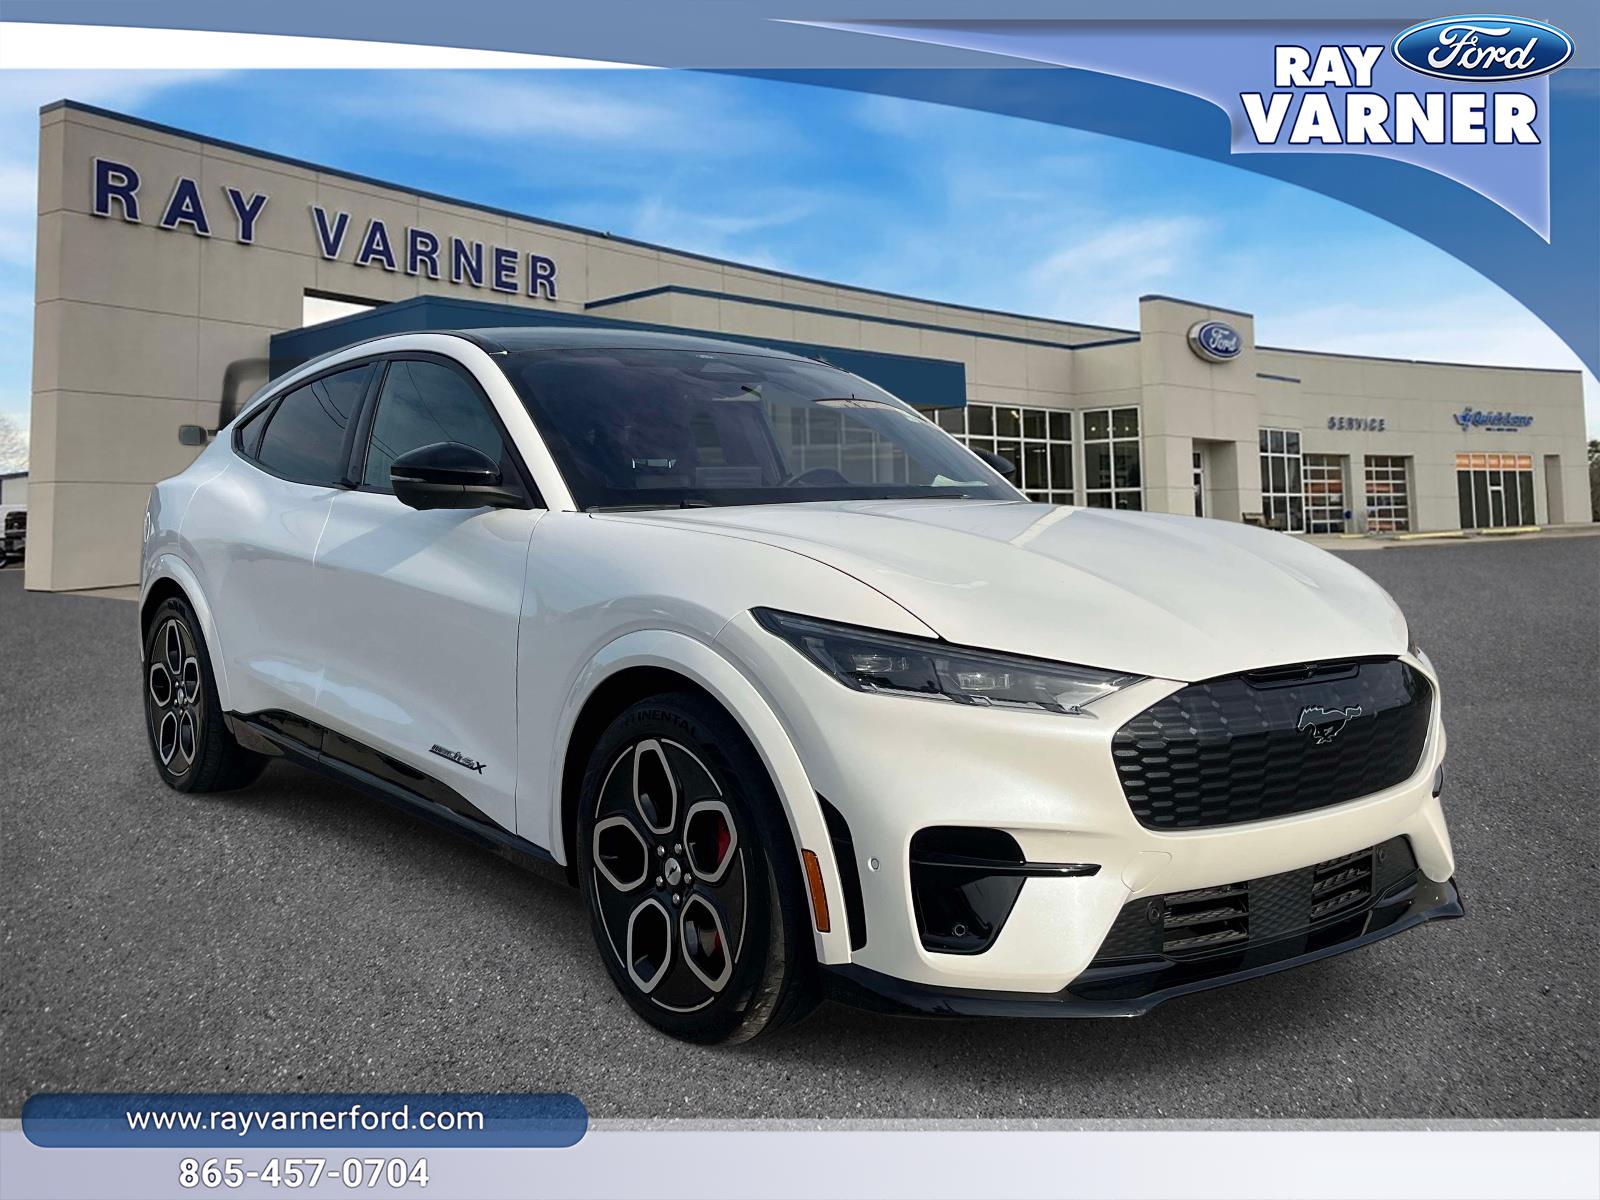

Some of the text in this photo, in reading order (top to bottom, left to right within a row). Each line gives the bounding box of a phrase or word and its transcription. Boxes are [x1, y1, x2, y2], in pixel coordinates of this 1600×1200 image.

[93, 156, 558, 300] RAY VARNER
[1209, 327, 1238, 352] Ford
[1327, 416, 1385, 432] SERVICE
